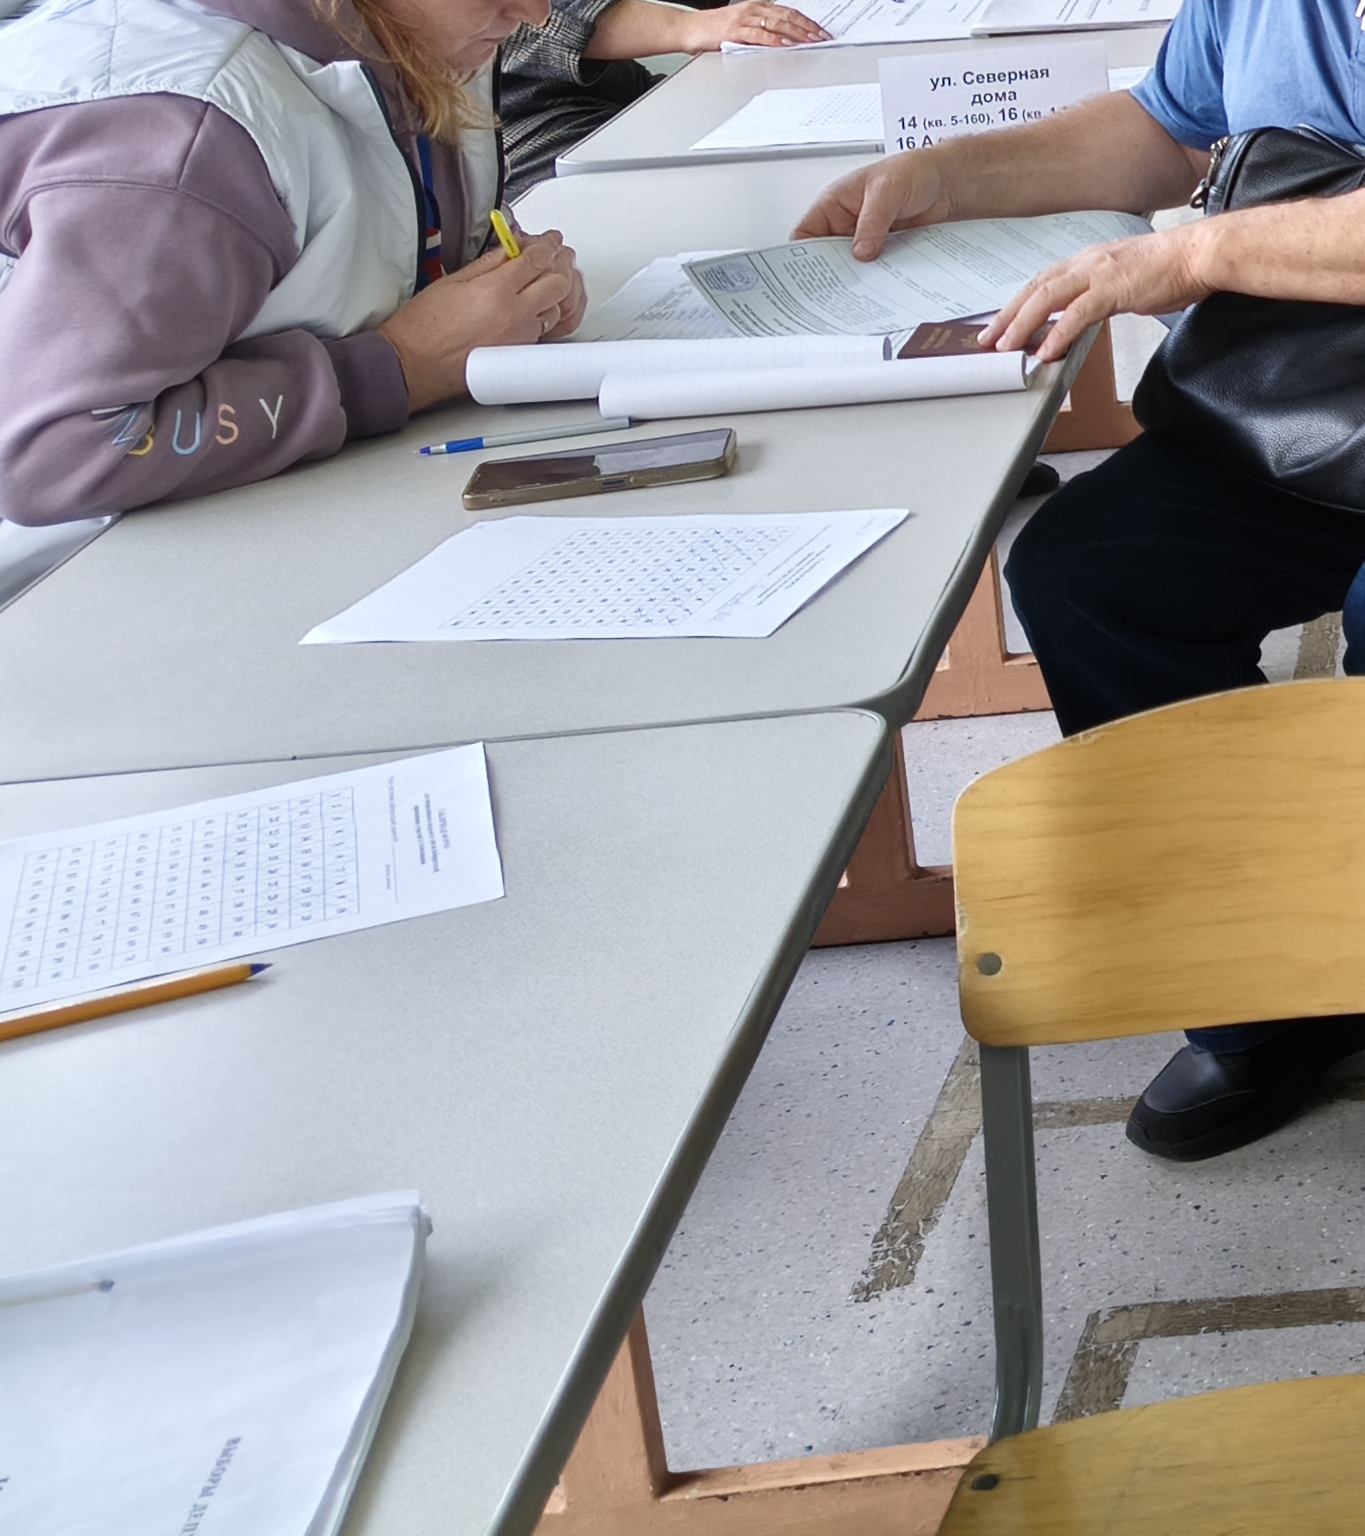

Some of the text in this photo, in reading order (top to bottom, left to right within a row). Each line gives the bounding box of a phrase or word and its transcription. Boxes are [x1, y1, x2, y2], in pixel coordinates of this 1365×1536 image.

[930, 67, 1049, 91] ул. Северная
[971, 90, 1017, 106] дома
[898, 116, 917, 131] 14
[923, 117, 946, 130] (кв.
[950, 113, 994, 126] 5-160),
[998, 107, 1018, 122] 16
[896, 134, 934, 150] 16 А
[180, 1436, 242, 1536] ВЫБОРЫ ДЕП
